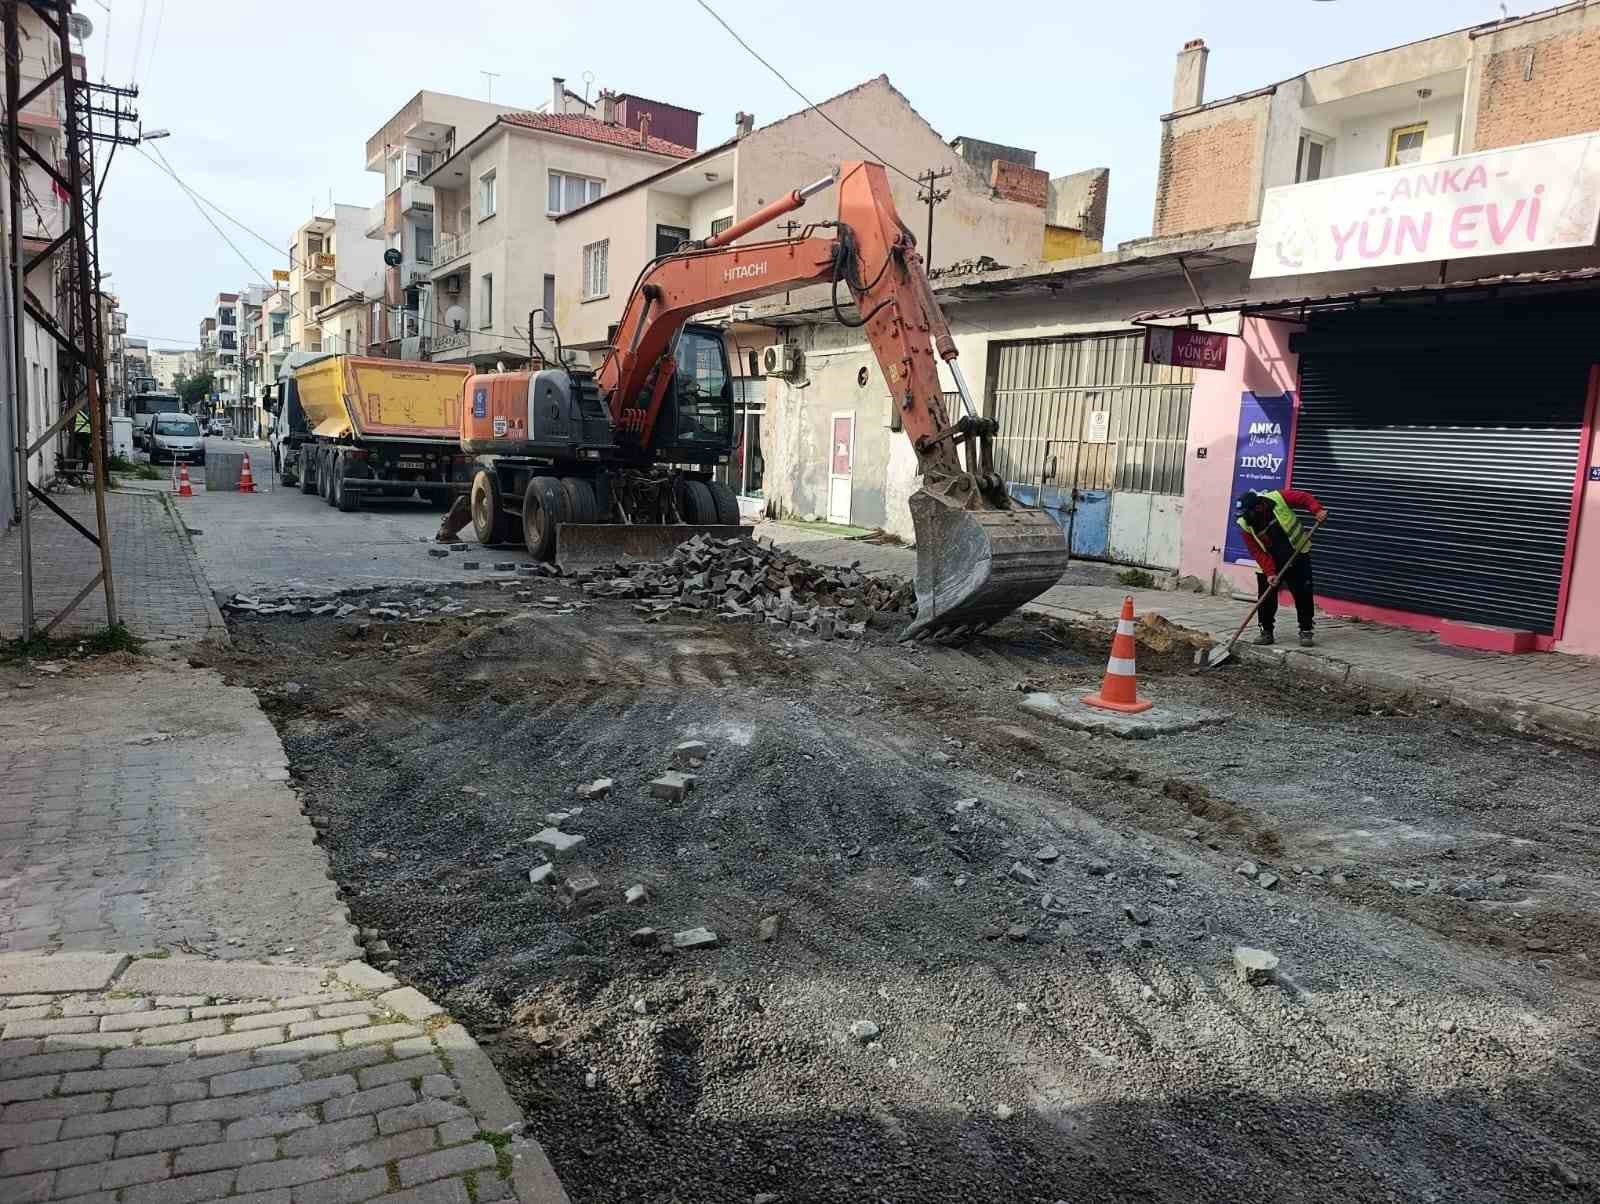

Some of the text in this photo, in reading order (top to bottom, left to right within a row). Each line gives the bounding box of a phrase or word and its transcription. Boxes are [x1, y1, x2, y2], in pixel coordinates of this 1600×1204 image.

[1330, 184, 1545, 262] YÜN EVİ
[723, 260, 768, 281] HITACHI
[1189, 335, 1213, 346] ANKA
[1177, 343, 1223, 361] YÜN EVİ
[1248, 422, 1282, 435] ANKA
[1240, 453, 1283, 473] moly
